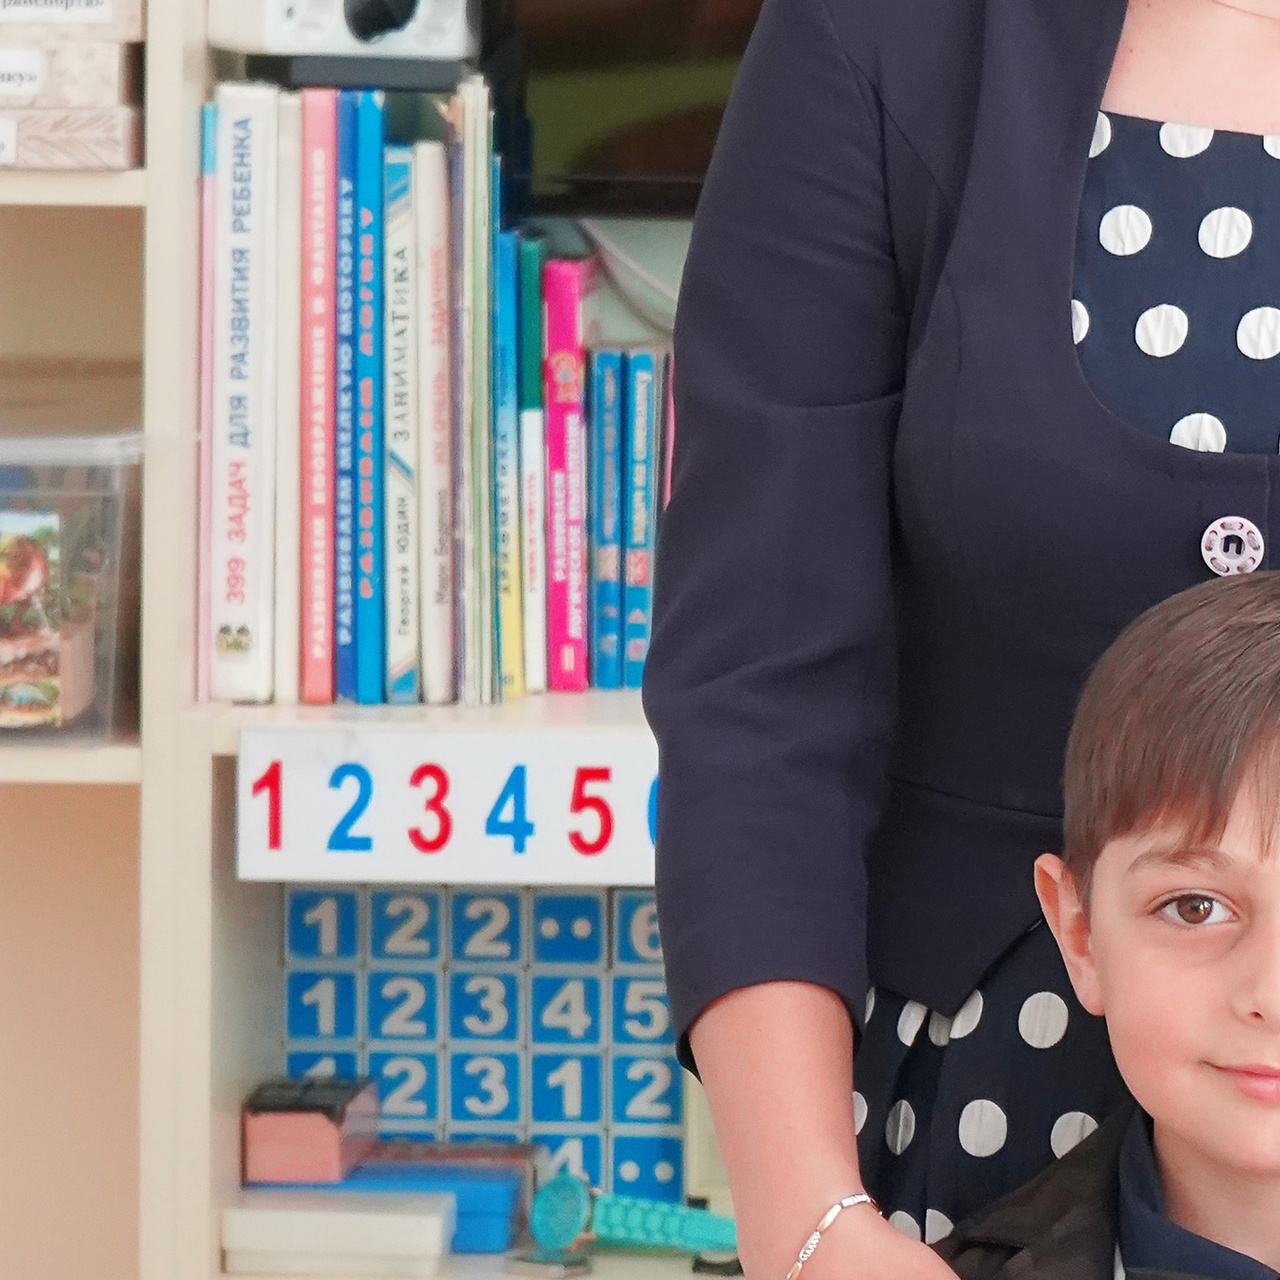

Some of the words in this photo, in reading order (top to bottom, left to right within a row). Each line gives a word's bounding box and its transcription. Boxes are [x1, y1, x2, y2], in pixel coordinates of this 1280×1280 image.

[231, 117, 253, 233] РЕБЕНКА
[311, 149, 326, 285] ФАНТАЗИЮ
[230, 248, 252, 380] РАЗВИТИЯ
[338, 176, 353, 334] МОТОРИКУ
[359, 206, 375, 356] ЛОГИКУ
[338, 343, 353, 470] МЕЛКУЮ
[391, 246, 411, 442] ЗАНИМАТИКА
[228, 395, 252, 448] ДЛЯ
[311, 327, 326, 504] ВООБРАЖЕНИЕ
[227, 460, 251, 543] ЗАДАЧ
[359, 377, 375, 598] РАЗВИВАЕМ
[226, 558, 247, 604] 399
[311, 517, 326, 659] РАЗВИВАЕМ
[338, 475, 353, 644] РАЗВИВАЕМ
[252, 761, 283, 851] 1
[327, 763, 374, 852] 2
[408, 763, 453, 855] 3
[485, 764, 535, 854] 4
[568, 767, 615, 856] 5
[305, 898, 338, 955] 1
[385, 897, 430, 955] 2
[464, 898, 511, 957] 2
[630, 902, 663, 961] 6
[302, 978, 336, 1036] 1
[381, 977, 427, 1036] 2
[464, 976, 510, 1035] 3
[541, 980, 592, 1038] 4
[624, 980, 671, 1039] 5
[381, 1057, 427, 1116] 2
[464, 1056, 510, 1116] 3
[547, 1059, 582, 1118] 1
[625, 1059, 672, 1117] 2
